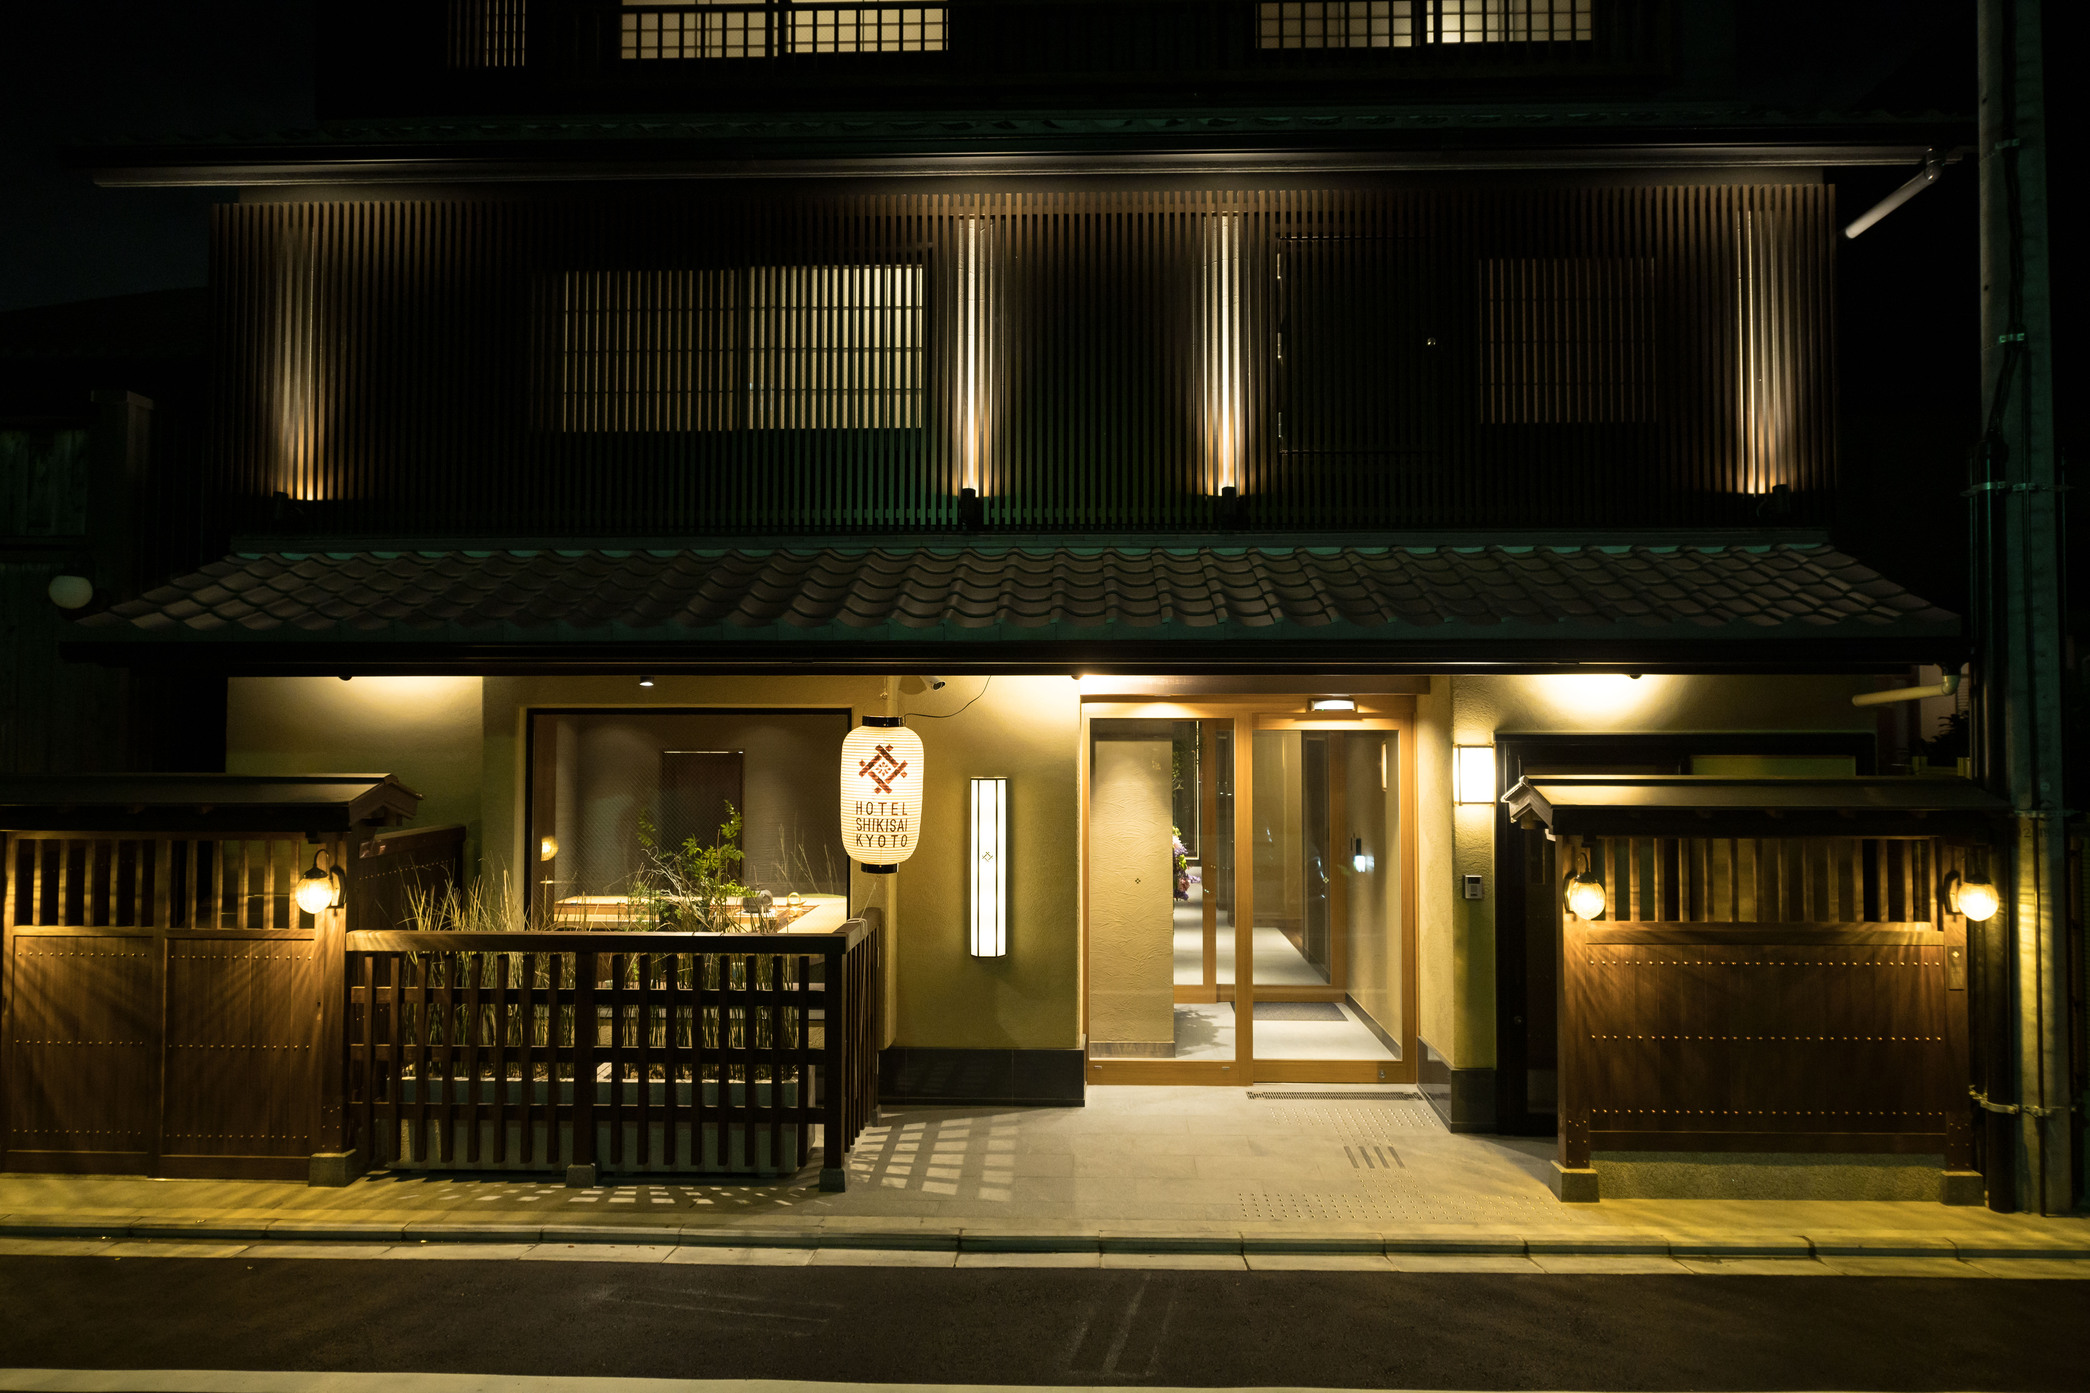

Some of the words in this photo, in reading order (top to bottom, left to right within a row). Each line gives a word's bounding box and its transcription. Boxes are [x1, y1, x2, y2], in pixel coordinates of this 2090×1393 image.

[855, 800, 908, 816] HOTEL
[855, 817, 908, 832] SHIKISAI
[855, 834, 908, 848] KYOTO
